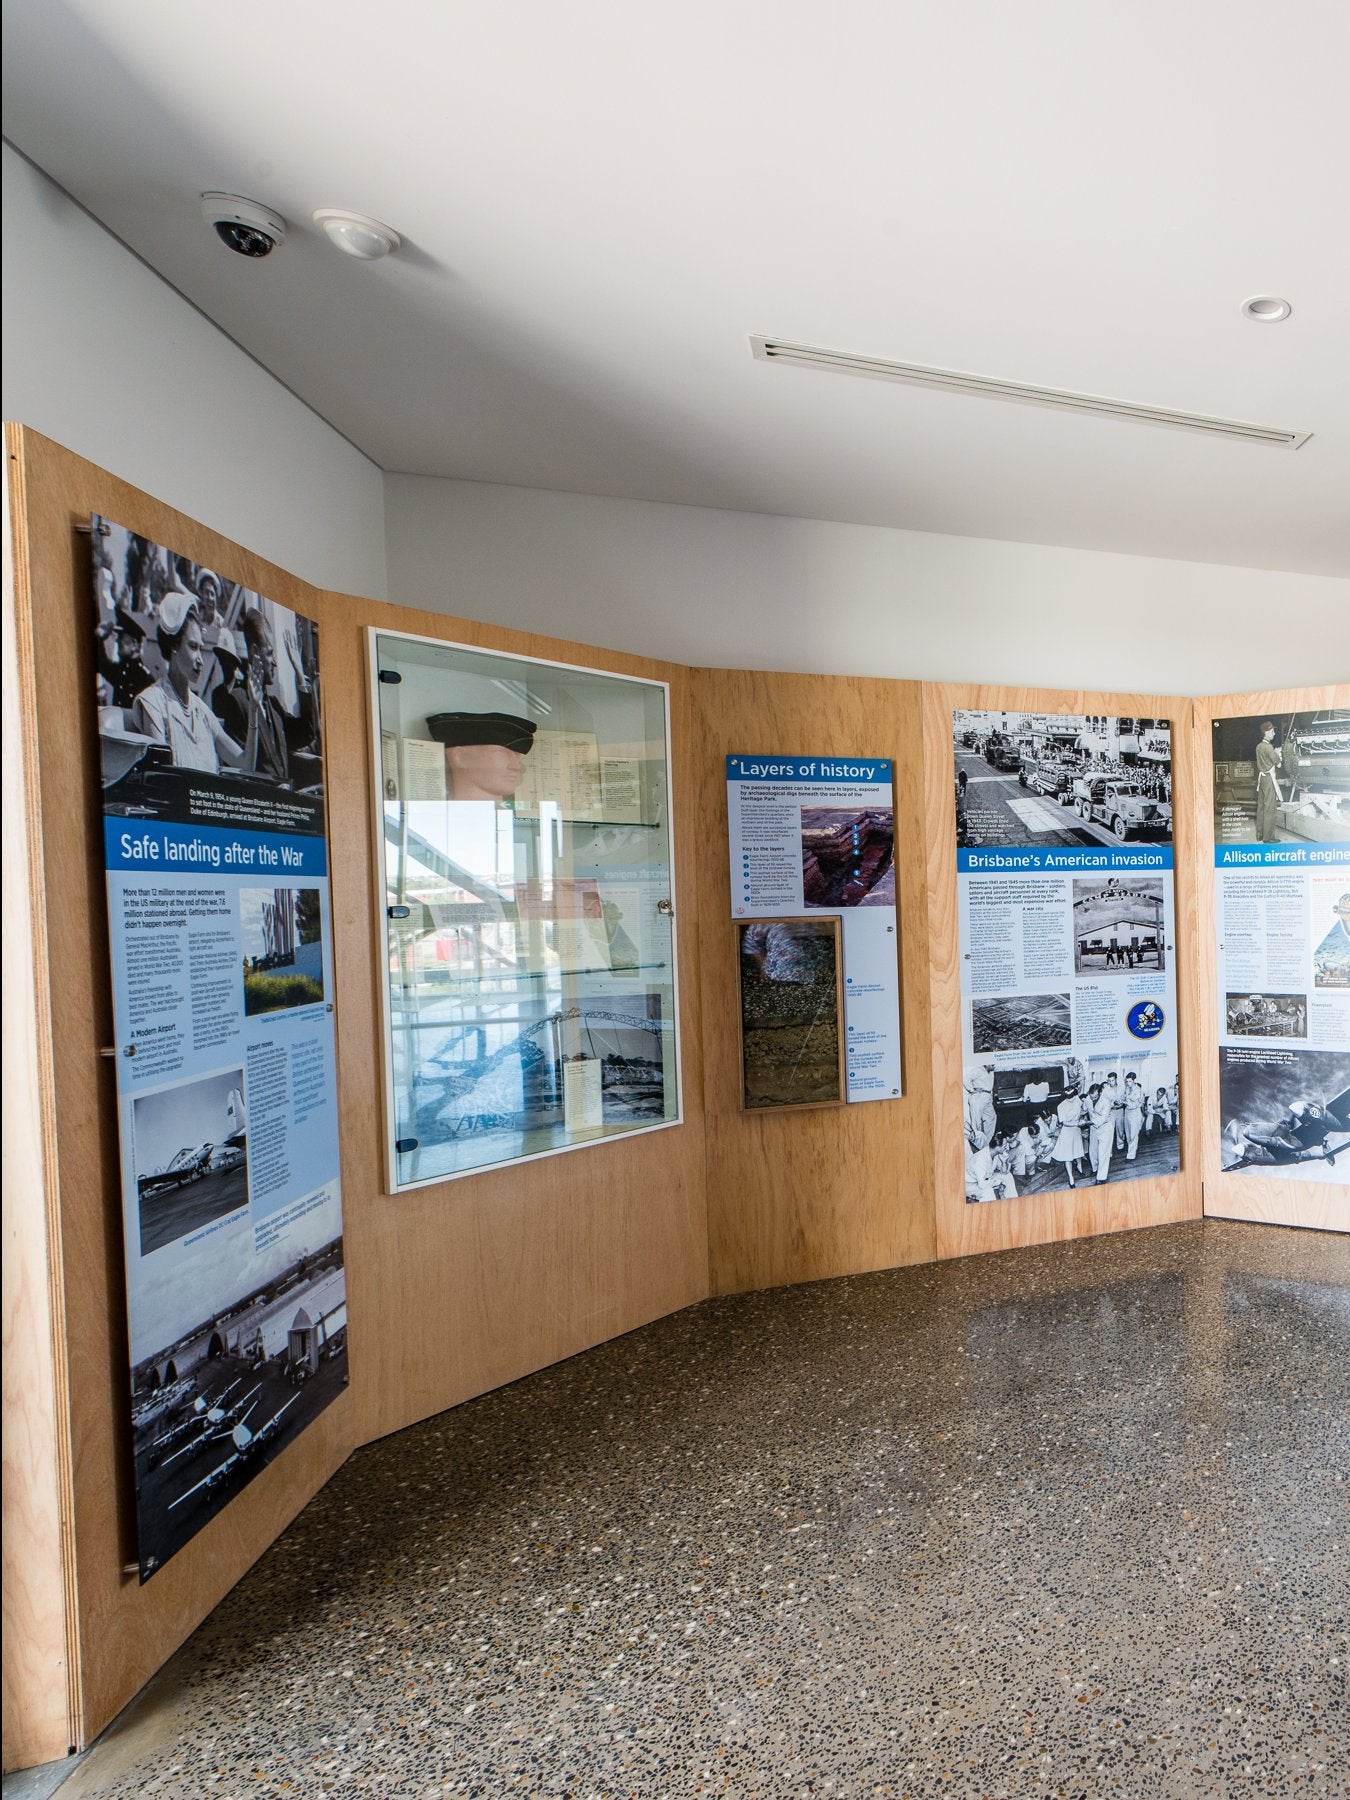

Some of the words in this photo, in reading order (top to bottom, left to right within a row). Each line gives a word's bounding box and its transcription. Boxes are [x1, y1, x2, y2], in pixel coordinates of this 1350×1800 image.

[740, 762, 794, 778] Layers
[800, 763, 815, 775] of
[821, 764, 875, 779] history
[120, 834, 159, 860] Safe
[164, 837, 220, 866] landing
[224, 843, 255, 865] after
[258, 844, 278, 866] the
[280, 847, 303, 867] War
[1223, 851, 1261, 862] Allison
[1265, 850, 1306, 862] aircraft
[968, 854, 1041, 867] Brisbane’s
[1045, 854, 1107, 866] American
[1111, 854, 1163, 865] invasion
[150, 899, 169, 908] military
[188, 908, 206, 917] Getting
[142, 920, 162, 929] happen
[136, 1028, 156, 1037] Modern
[158, 1024, 176, 1034] Airport
